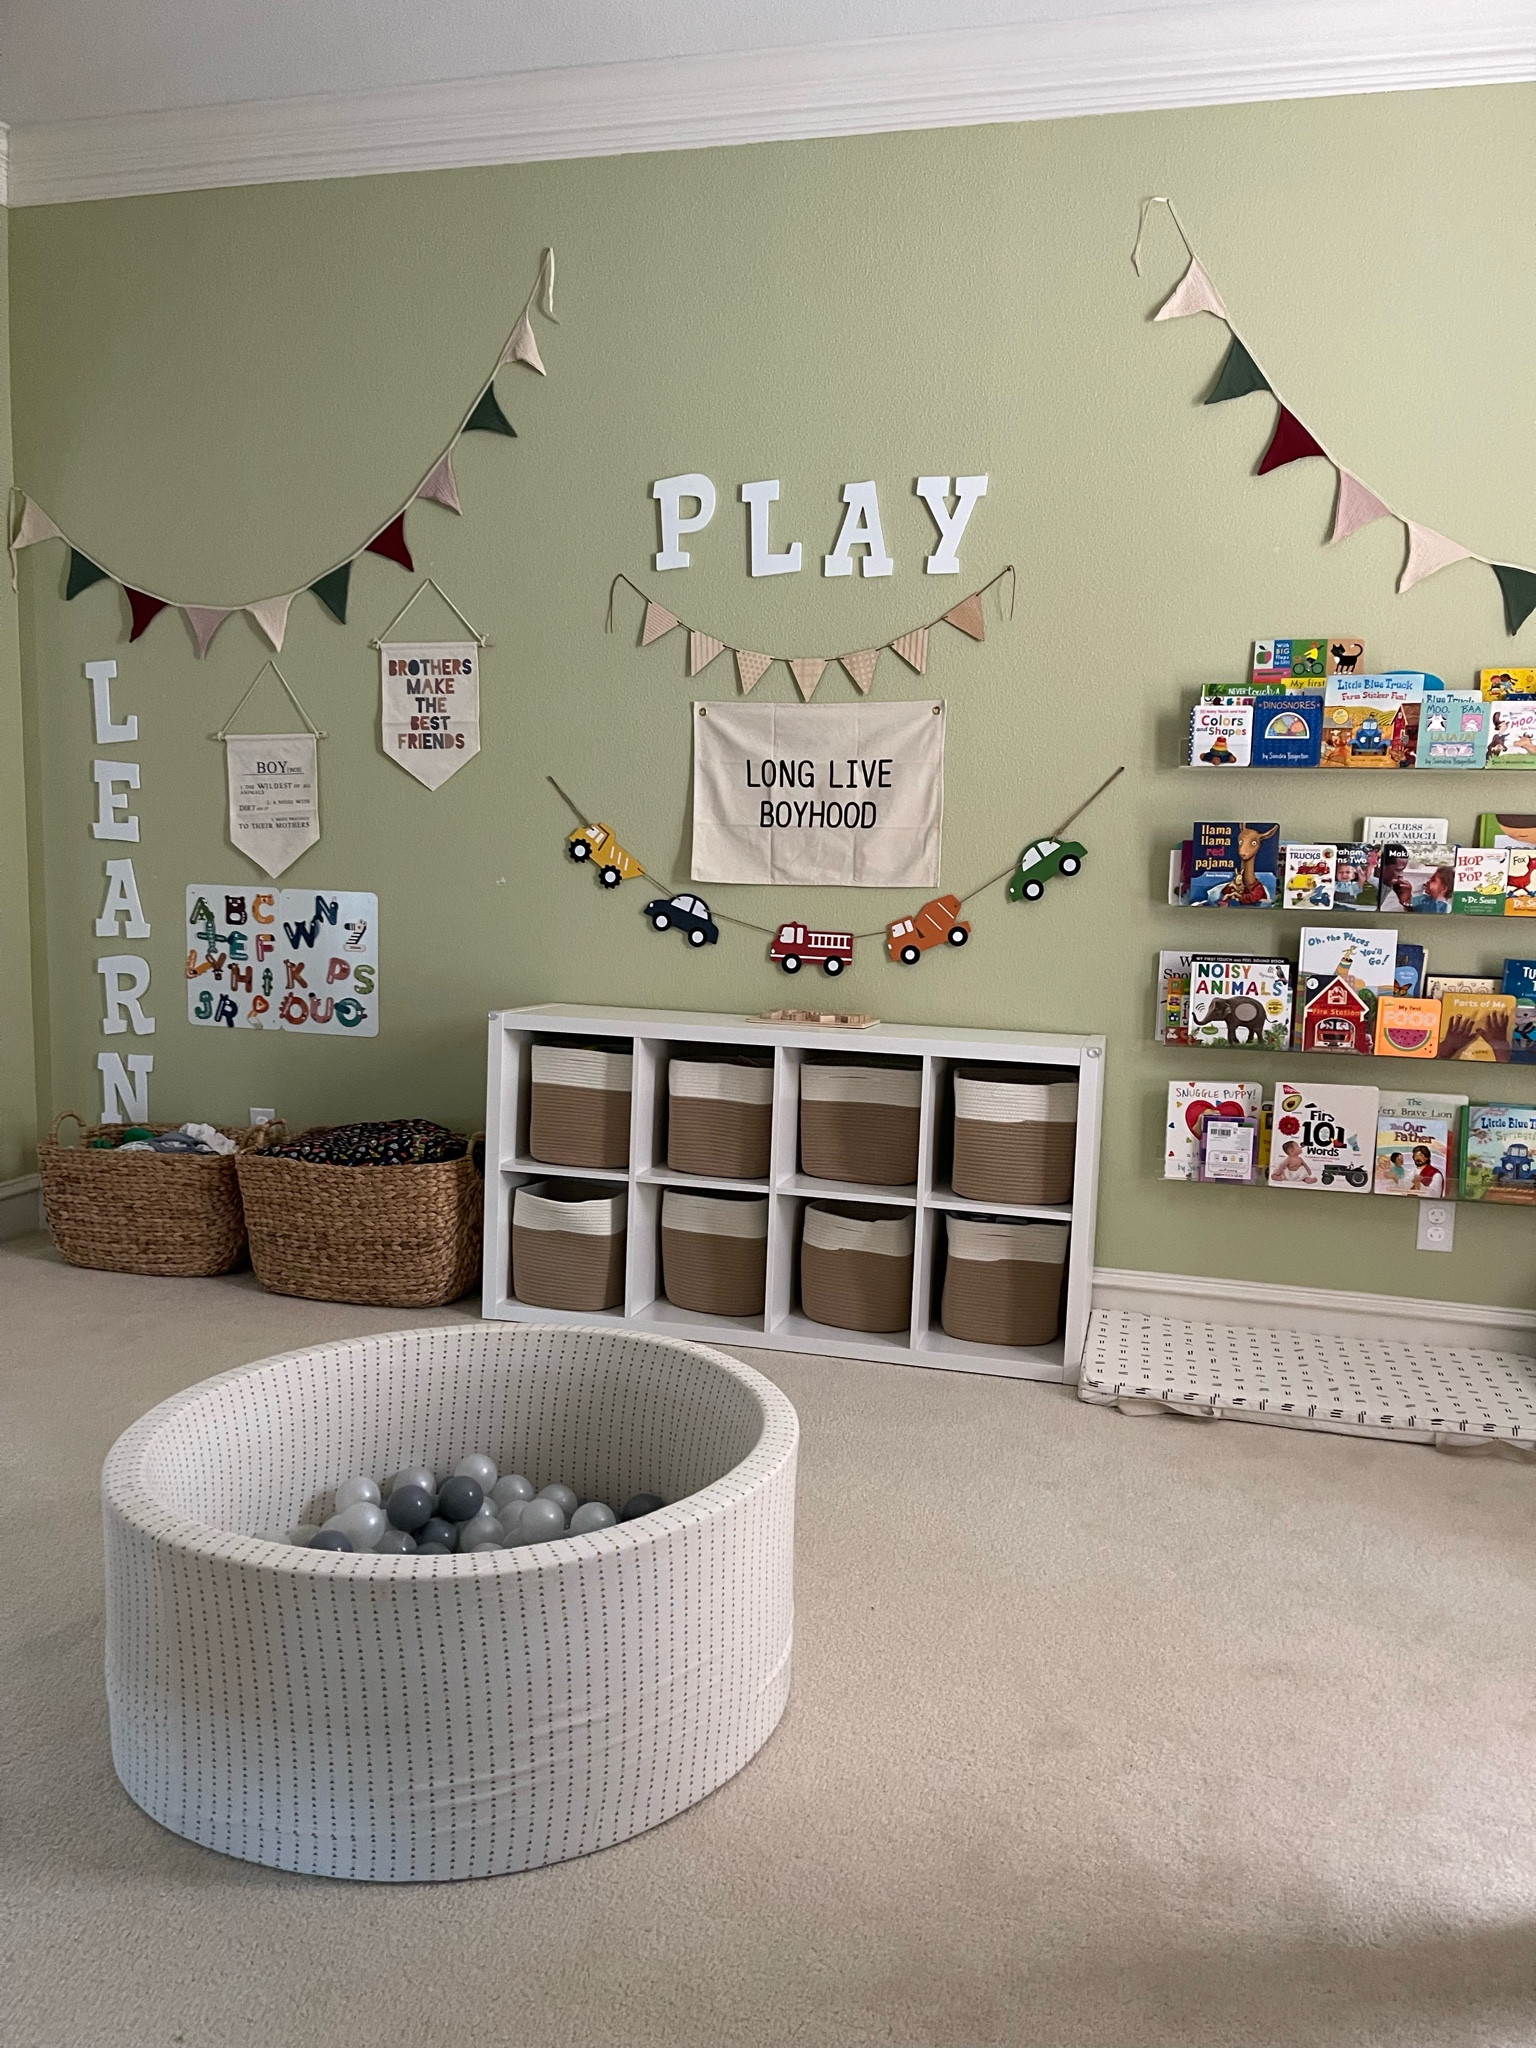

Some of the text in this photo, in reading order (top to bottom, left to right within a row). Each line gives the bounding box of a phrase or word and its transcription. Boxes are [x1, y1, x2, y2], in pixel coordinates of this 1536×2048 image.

[652, 473, 989, 578] PLAY
[388, 658, 472, 676] BROTHERS
[406, 678, 455, 694] MAKE
[1290, 677, 1326, 689] My first
[1337, 678, 1413, 690] Little Blue Truck
[1228, 687, 1247, 695] NEVER
[1247, 684, 1275, 696] touch
[1341, 691, 1408, 701] Farm Sticker Fun!
[415, 697, 447, 713] THE
[1263, 701, 1316, 710] DINOSNORES
[410, 715, 451, 731] BEST
[1201, 715, 1244, 726] Colors
[1208, 727, 1247, 737] Shapes
[397, 733, 465, 749] FRIENDS
[256, 761, 288, 774] BOY
[746, 759, 893, 788] LONG LIVE
[760, 800, 877, 829] BOYHOOD
[1201, 825, 1232, 835] llama
[1389, 823, 1422, 831] GUESS
[1201, 835, 1231, 846] llama
[1374, 831, 1436, 840] HOW MUCH
[1206, 847, 1225, 856] red
[1290, 852, 1321, 860] TRUCKS
[1195, 858, 1234, 870] pajama
[1350, 856, 1367, 864] Two
[1458, 856, 1483, 866] HOP
[1513, 856, 1526, 865] Fox
[1458, 872, 1482, 882] POP
[84, 660, 156, 1124] LEARN
[1513, 900, 1525, 908] Dr.
[1343, 932, 1370, 947] Places
[1360, 948, 1383, 957] You'll
[1368, 954, 1390, 966] Go!
[1198, 963, 1252, 979] NOISY
[1195, 980, 1283, 996] ANIMALS
[1454, 999, 1478, 1008] Parts
[1492, 1001, 1507, 1009] Me
[1330, 1008, 1361, 1016] Station
[1383, 1010, 1437, 1027] FOOD
[1176, 1088, 1257, 1099] SNUGGLE PUPPY!
[1406, 1098, 1422, 1106] The
[1401, 1108, 1427, 1117] Brave
[1431, 1109, 1453, 1118] Lion
[1402, 1121, 1427, 1133] Our
[1481, 1117, 1507, 1129] Little
[1508, 1117, 1529, 1129] Blue
[1301, 1121, 1347, 1149] 101
[1394, 1131, 1436, 1144] Father
[1307, 1147, 1340, 1157] Words
